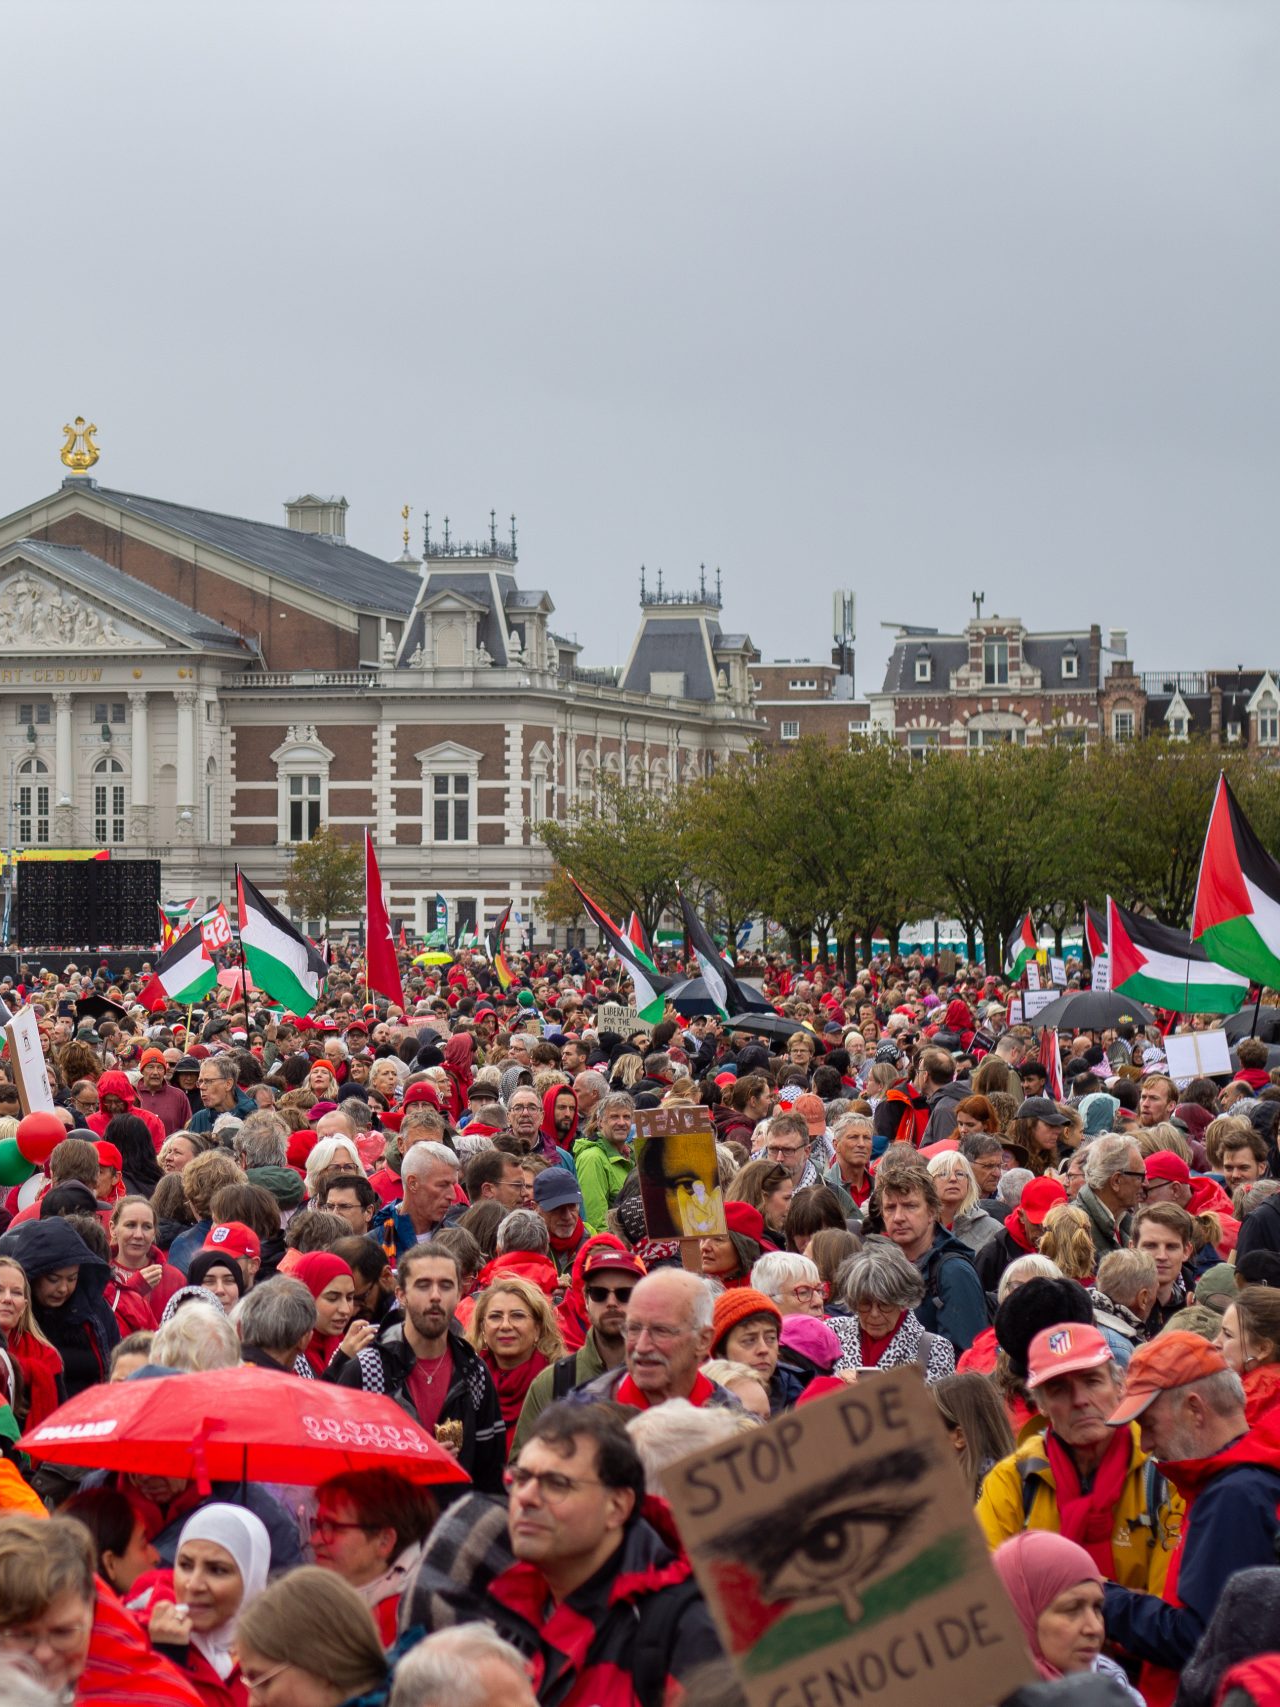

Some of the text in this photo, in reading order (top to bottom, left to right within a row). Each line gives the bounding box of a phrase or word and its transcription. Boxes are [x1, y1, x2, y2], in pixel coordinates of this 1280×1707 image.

[603, 1007, 640, 1018] LIBERATIO
[604, 1017, 630, 1026] FOR THE
[684, 1385, 911, 1518] STOP DE
